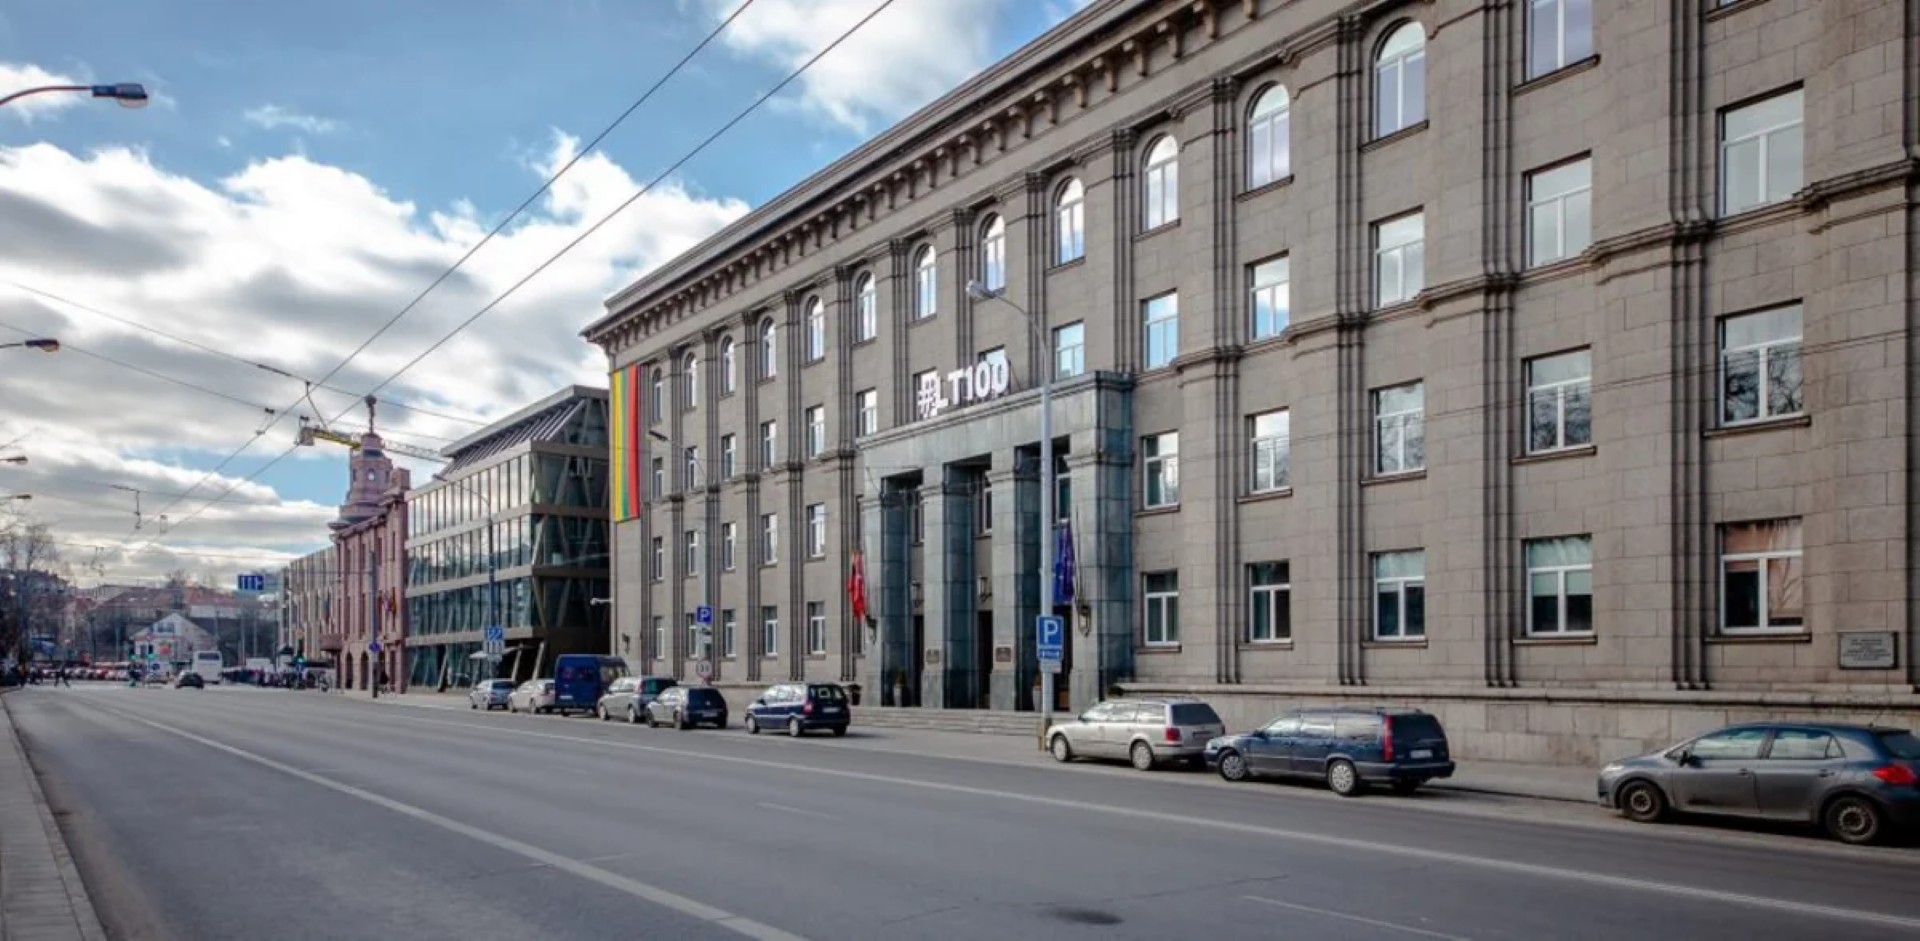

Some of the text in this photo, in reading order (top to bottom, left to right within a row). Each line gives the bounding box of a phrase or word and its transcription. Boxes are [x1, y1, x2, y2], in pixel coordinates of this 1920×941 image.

[917, 358, 1009, 418] #LT100
[700, 609, 710, 622] P
[1043, 620, 1058, 644] P
